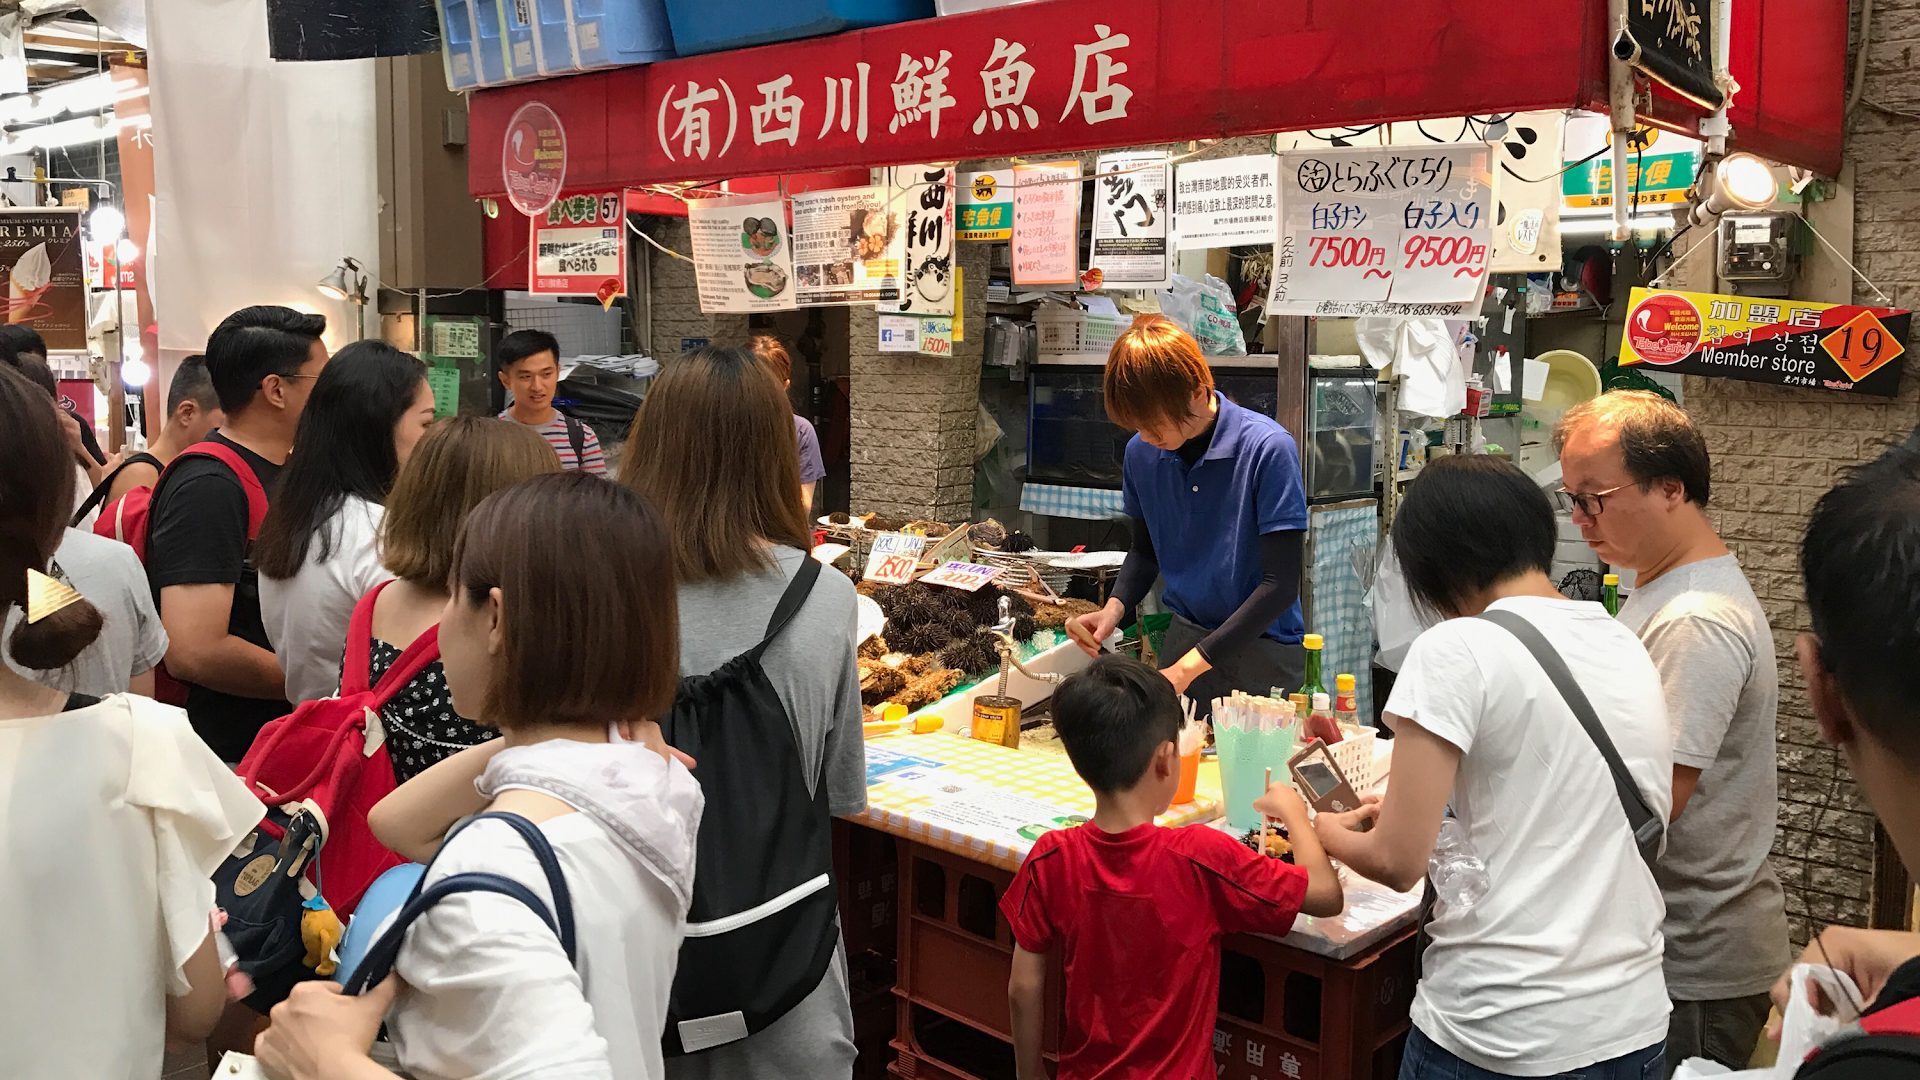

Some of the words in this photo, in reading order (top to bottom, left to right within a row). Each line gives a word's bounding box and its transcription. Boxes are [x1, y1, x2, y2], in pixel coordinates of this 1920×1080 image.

[547, 195, 598, 226] 食べ歩き
[602, 197, 619, 220] 57
[837, 194, 861, 203] oysters
[841, 202, 857, 211] front
[962, 206, 1002, 227] 宅急便
[1312, 202, 1367, 230] 白子ナシ
[1405, 201, 1480, 229] 白子入り
[0, 226, 73, 238] REMIA
[558, 257, 598, 273] 食べられる
[1279, 236, 1294, 268] 2人前
[1273, 273, 1288, 302] 3人前
[1664, 322, 1700, 331] Welcome
[1708, 300, 1824, 329] 加盟店
[922, 337, 951, 354] 1500円
[1704, 325, 1753, 347] 참여
[1770, 331, 1818, 355] 상점
[1840, 326, 1885, 370] 19
[1700, 346, 1769, 370] Member
[1771, 354, 1816, 375] store
[904, 537, 924, 550] UNI
